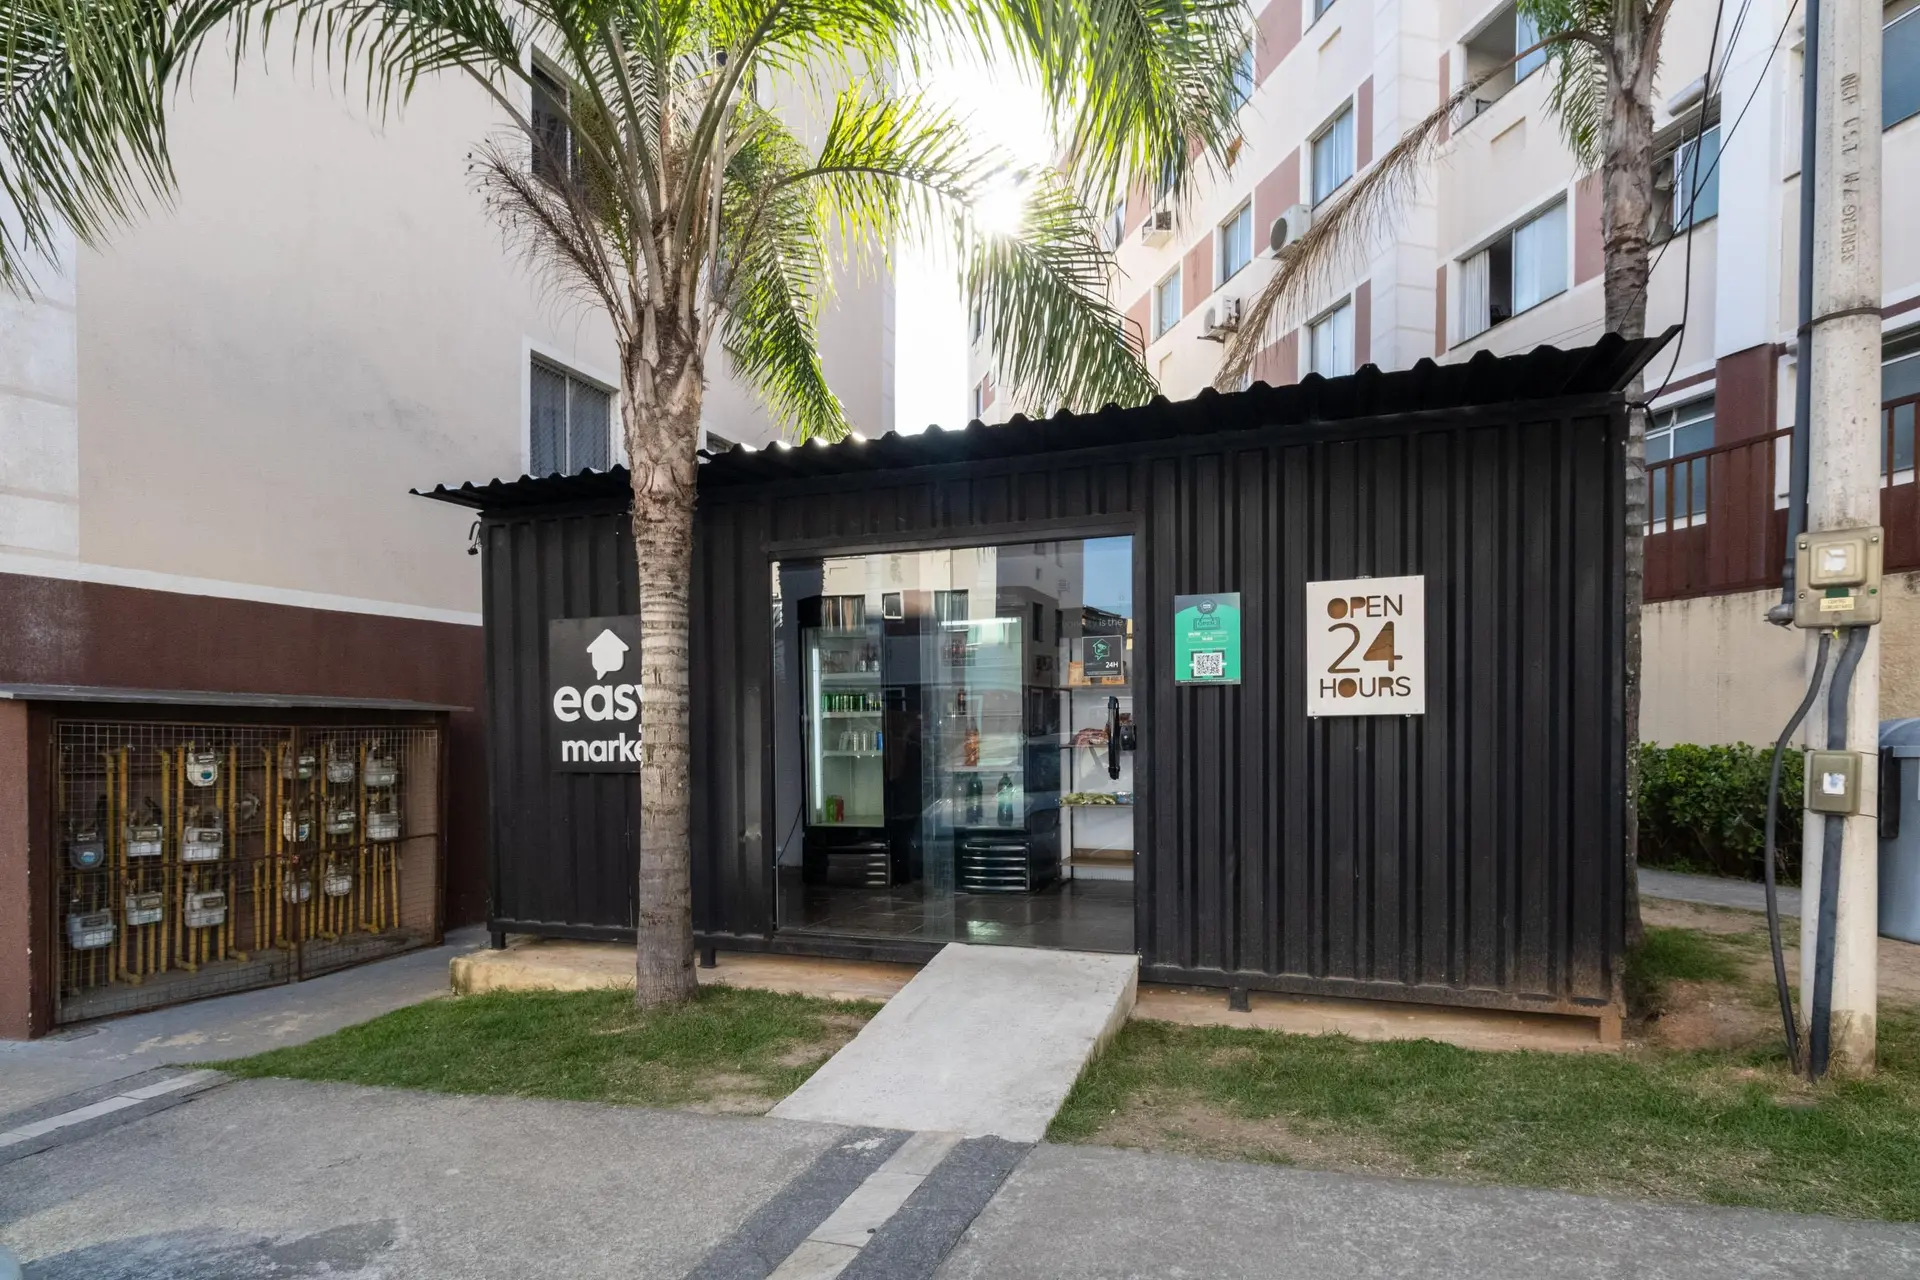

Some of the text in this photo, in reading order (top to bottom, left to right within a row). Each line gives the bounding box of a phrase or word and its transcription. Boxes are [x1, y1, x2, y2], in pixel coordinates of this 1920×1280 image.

[1327, 594, 1402, 619] OPEN
[1099, 619, 1106, 627] is
[1107, 618, 1123, 627] the
[1327, 621, 1403, 673] 24
[1105, 661, 1119, 669] 24H
[1320, 676, 1411, 698] HOURS
[553, 684, 643, 732] eas
